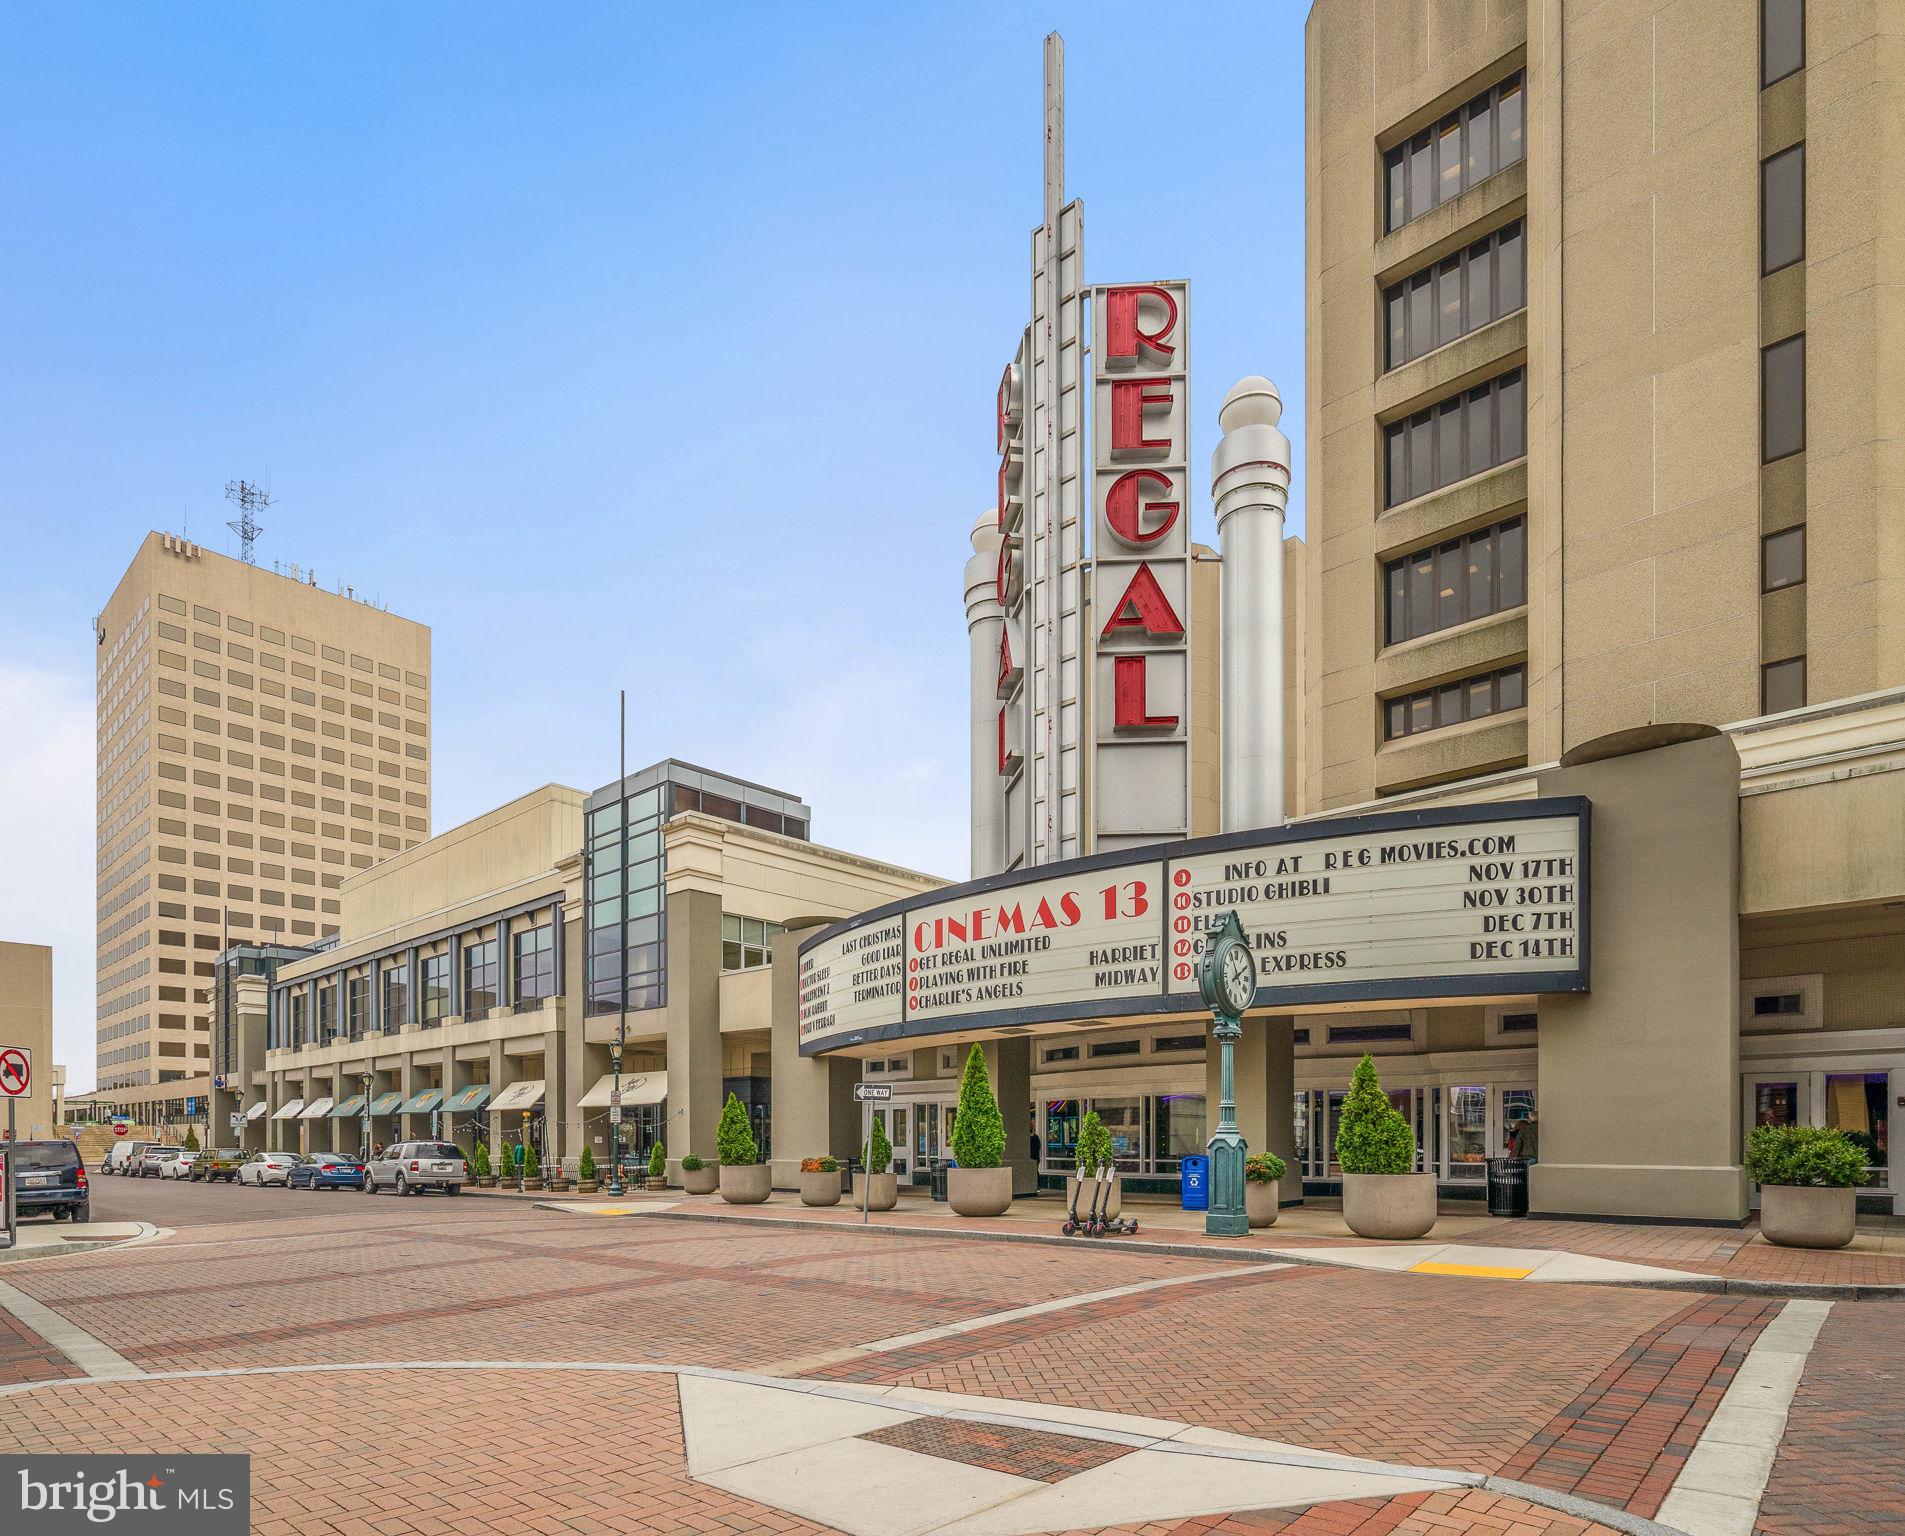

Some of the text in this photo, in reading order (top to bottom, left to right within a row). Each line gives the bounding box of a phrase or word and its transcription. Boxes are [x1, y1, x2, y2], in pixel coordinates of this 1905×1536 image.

[1101, 286, 1184, 730] REGAL
[1224, 860, 1267, 881] INFO
[1276, 856, 1302, 875] AT
[1380, 835, 1515, 864] MOVIES.COM
[1469, 858, 1573, 882] NOV 17TH
[1193, 885, 1259, 908] STUDIO
[1264, 877, 1330, 900] GHIBLI
[1463, 884, 1573, 908] NOV 30TH
[914, 880, 1149, 953] CINEMAS 13
[1193, 913, 1218, 931] EL
[1483, 911, 1573, 932] DEC 7TH
[842, 925, 901, 955] LAST CHRISTMAS
[1470, 938, 1573, 959] DEC 14TH
[861, 944, 901, 966] GOOD LIAR
[919, 954, 938, 971] GET
[941, 947, 976, 967] REGAL
[981, 935, 1051, 959] UNLIMITED
[1089, 943, 1159, 966] HARRIET
[1261, 950, 1347, 973] EXPRESS
[852, 963, 901, 986] BETTER DAYS
[919, 969, 964, 990] PLAYING
[966, 964, 997, 982] WITH
[1000, 960, 1029, 977] FIRE
[1095, 967, 1159, 988] MIDWAY
[853, 981, 901, 1003] TERMINATOR
[919, 988, 972, 1009] CHARLIE'S
[976, 981, 1023, 1001] ANGELS
